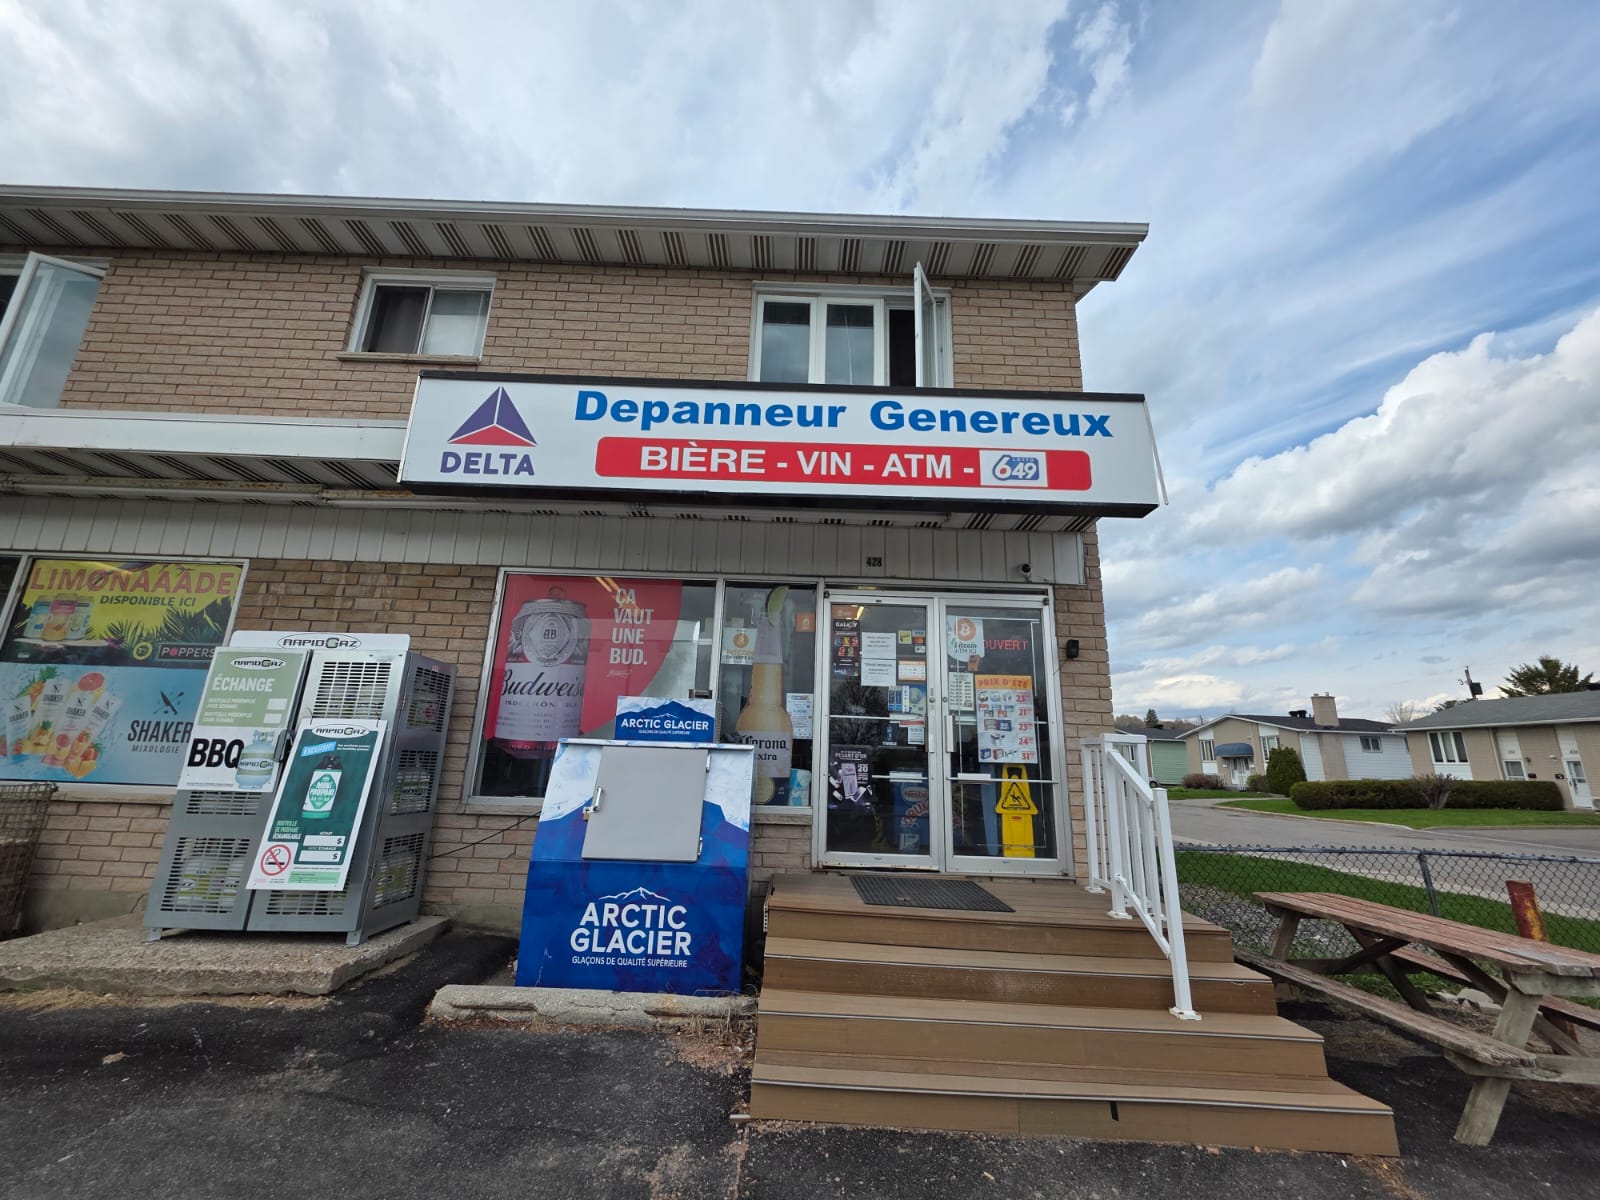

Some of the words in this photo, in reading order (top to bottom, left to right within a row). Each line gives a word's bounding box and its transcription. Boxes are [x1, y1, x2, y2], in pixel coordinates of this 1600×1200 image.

[575, 390, 847, 431] Depanneur
[870, 400, 1114, 437] Genereux
[440, 451, 535, 476] DELTA
[640, 441, 766, 474] BIÈRE
[796, 450, 851, 476] VIN
[881, 453, 952, 479] ATM
[866, 556, 882, 567] 428
[100, 595, 175, 606] DISPONIBLE
[178, 597, 196, 607] ICI
[616, 588, 636, 608] ÇA
[614, 608, 654, 625] VAUT
[612, 627, 645, 644] UNE
[609, 647, 647, 665] BUD.
[211, 673, 276, 692] ÉCHANGE
[501, 669, 584, 697] Budweis
[128, 719, 194, 744] SHAKER
[621, 718, 660, 728] ARCTIC
[663, 720, 709, 731] GLACIER
[187, 738, 245, 769] BBQ
[756, 753, 777, 761] xtra
[579, 902, 688, 930] ARCTIC
[570, 927, 692, 956] GLACIER
[571, 955, 605, 966] GLAÇONS
[606, 957, 616, 966] DE
[617, 957, 646, 967] QUALITÉ
[647, 957, 688, 968] SUPÉRIEURE
